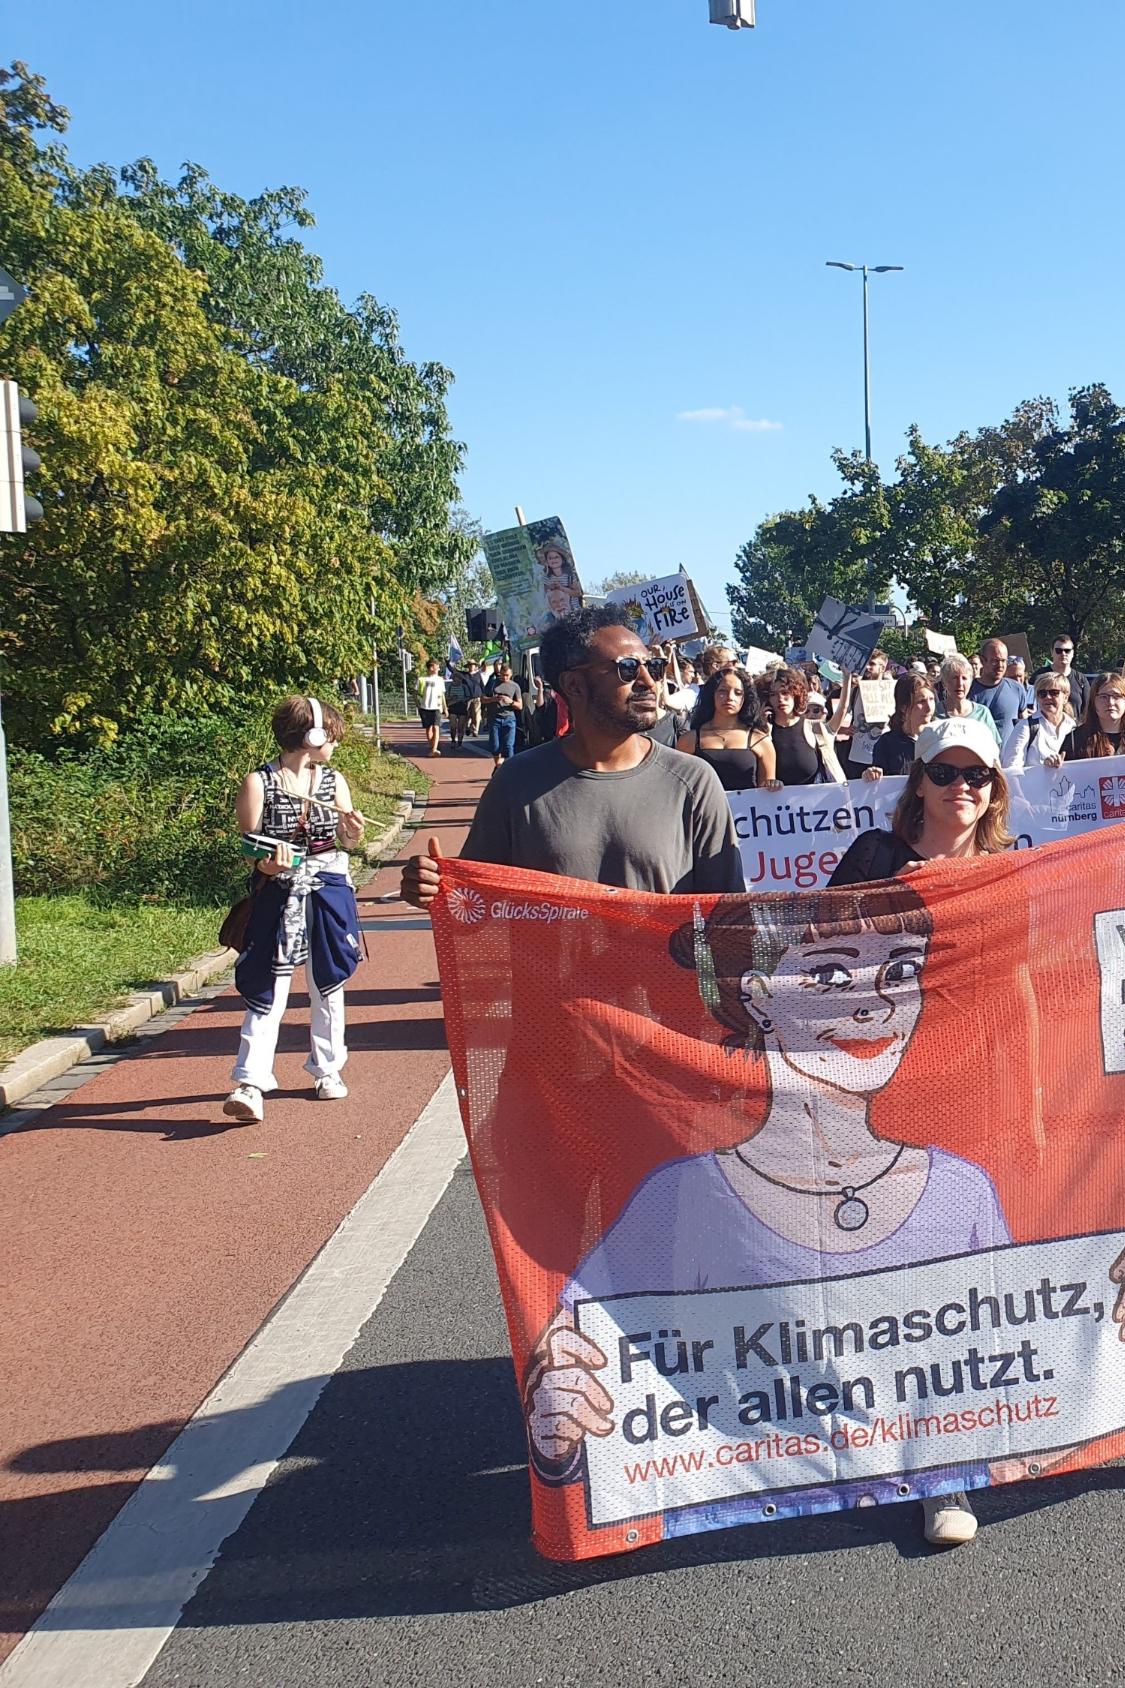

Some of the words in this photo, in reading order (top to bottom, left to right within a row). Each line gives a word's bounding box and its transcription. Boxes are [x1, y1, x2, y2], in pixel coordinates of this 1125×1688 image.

[734, 804, 875, 839] chützen
[1051, 812, 1098, 823] nürnberg
[1068, 802, 1097, 811] caritas
[750, 851, 839, 888] Juge
[491, 900, 589, 924] GlücksSpirale
[618, 1328, 714, 1384] Für
[734, 1277, 1105, 1369] Klimaschutz,
[622, 1393, 719, 1445] der
[737, 1375, 875, 1426] allen
[894, 1338, 1055, 1402] nutzt.
[623, 1391, 1060, 1484] www.caritas.de/klimaschutz
